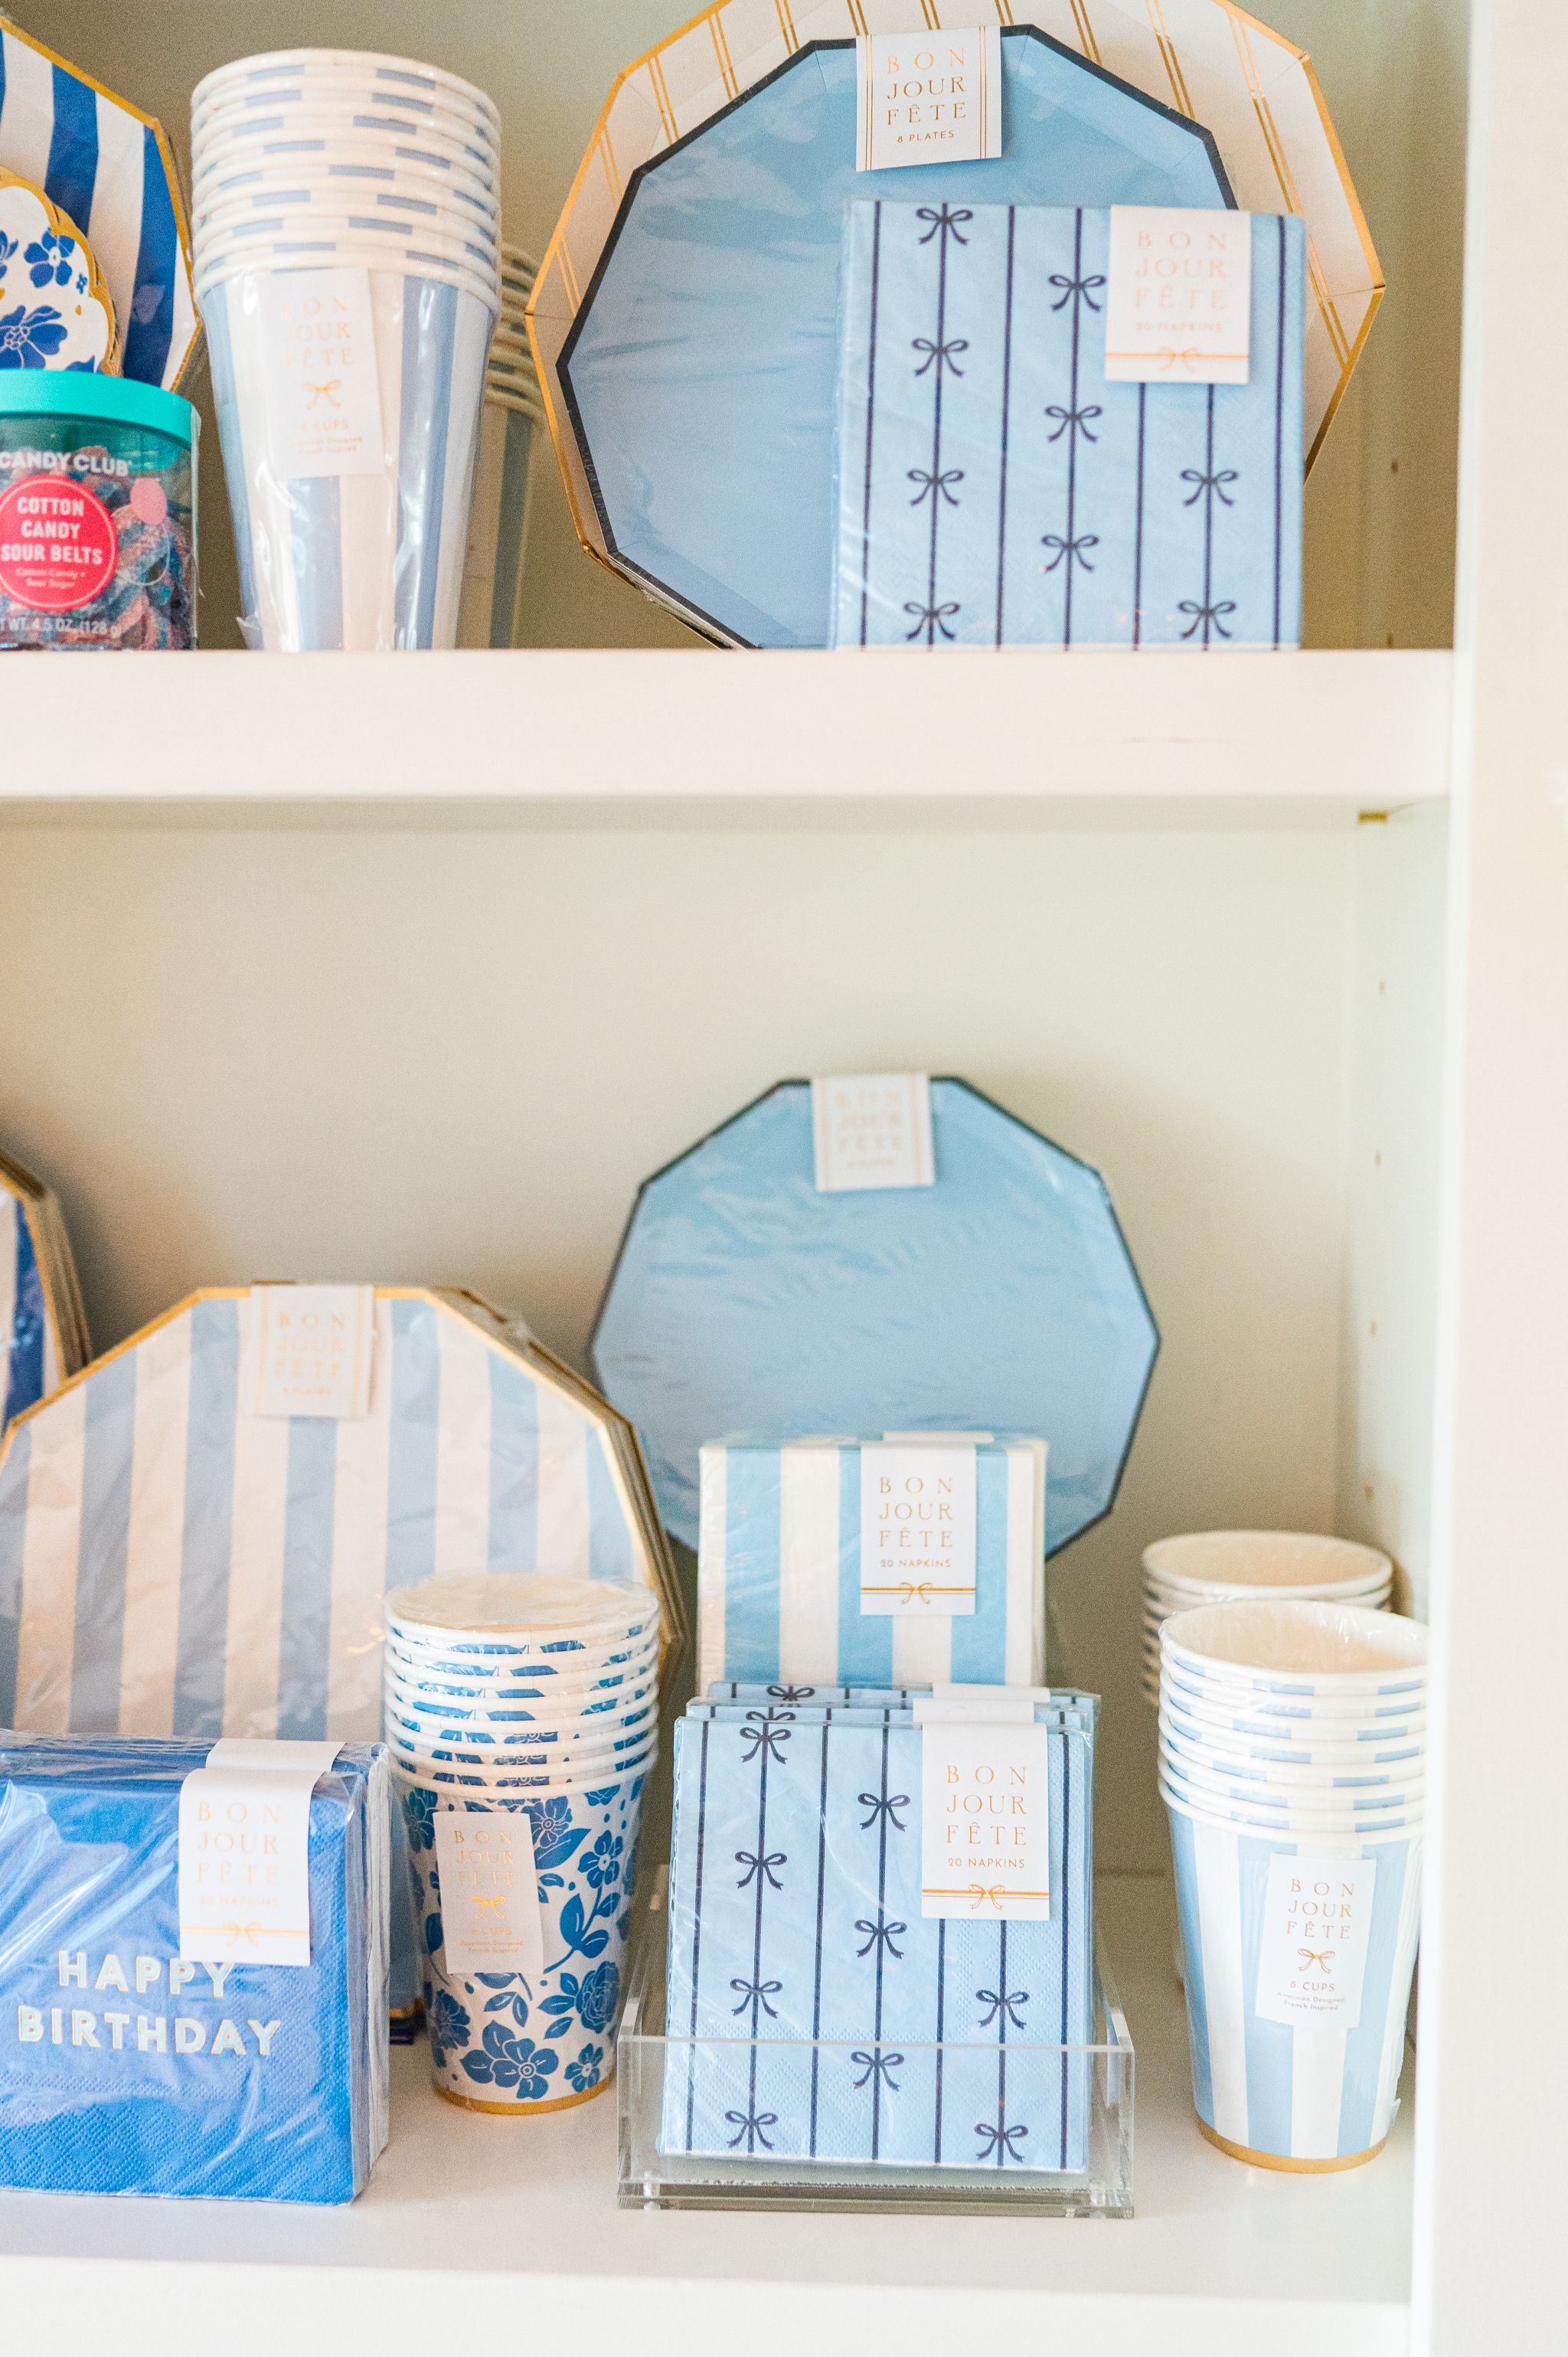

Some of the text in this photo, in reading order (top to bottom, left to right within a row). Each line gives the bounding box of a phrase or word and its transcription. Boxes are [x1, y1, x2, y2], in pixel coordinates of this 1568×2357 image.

[887, 47, 965, 74] BON
[887, 76, 966, 100] JOUR
[887, 103, 966, 125] FÊTE
[909, 130, 955, 142] PLATES
[1137, 231, 1227, 250] BON
[1135, 257, 1227, 278] JOUR
[0, 450, 72, 470] CANDY
[17, 496, 85, 516] COTTON
[21, 520, 81, 539] CANDY
[1, 544, 103, 565] SOUR BELTS
[879, 1476, 953, 1494] BON
[879, 1502, 953, 1520] JOUR
[879, 1527, 953, 1548] FÊTE
[881, 1559, 951, 1568] 20 NAPKINS
[946, 1765, 1027, 1785] BON
[198, 1800, 281, 1823] BON
[946, 1794, 1027, 1815] JOUR
[197, 1831, 280, 1855] JOUR
[454, 1830, 512, 1844] BON
[946, 1822, 1027, 1846] FÊTE
[455, 1850, 515, 1865] JOUR
[948, 1858, 1025, 1868] 20 NAPKINS
[1290, 1878, 1355, 1897] BON
[1288, 1900, 1353, 1918] JOUR
[1286, 1921, 1351, 1940] FÊTE
[58, 1950, 235, 1998] HAPPY
[1289, 1979, 1335, 1992] 8 CUPS
[18, 2005, 281, 2056] BIRTHDAY
